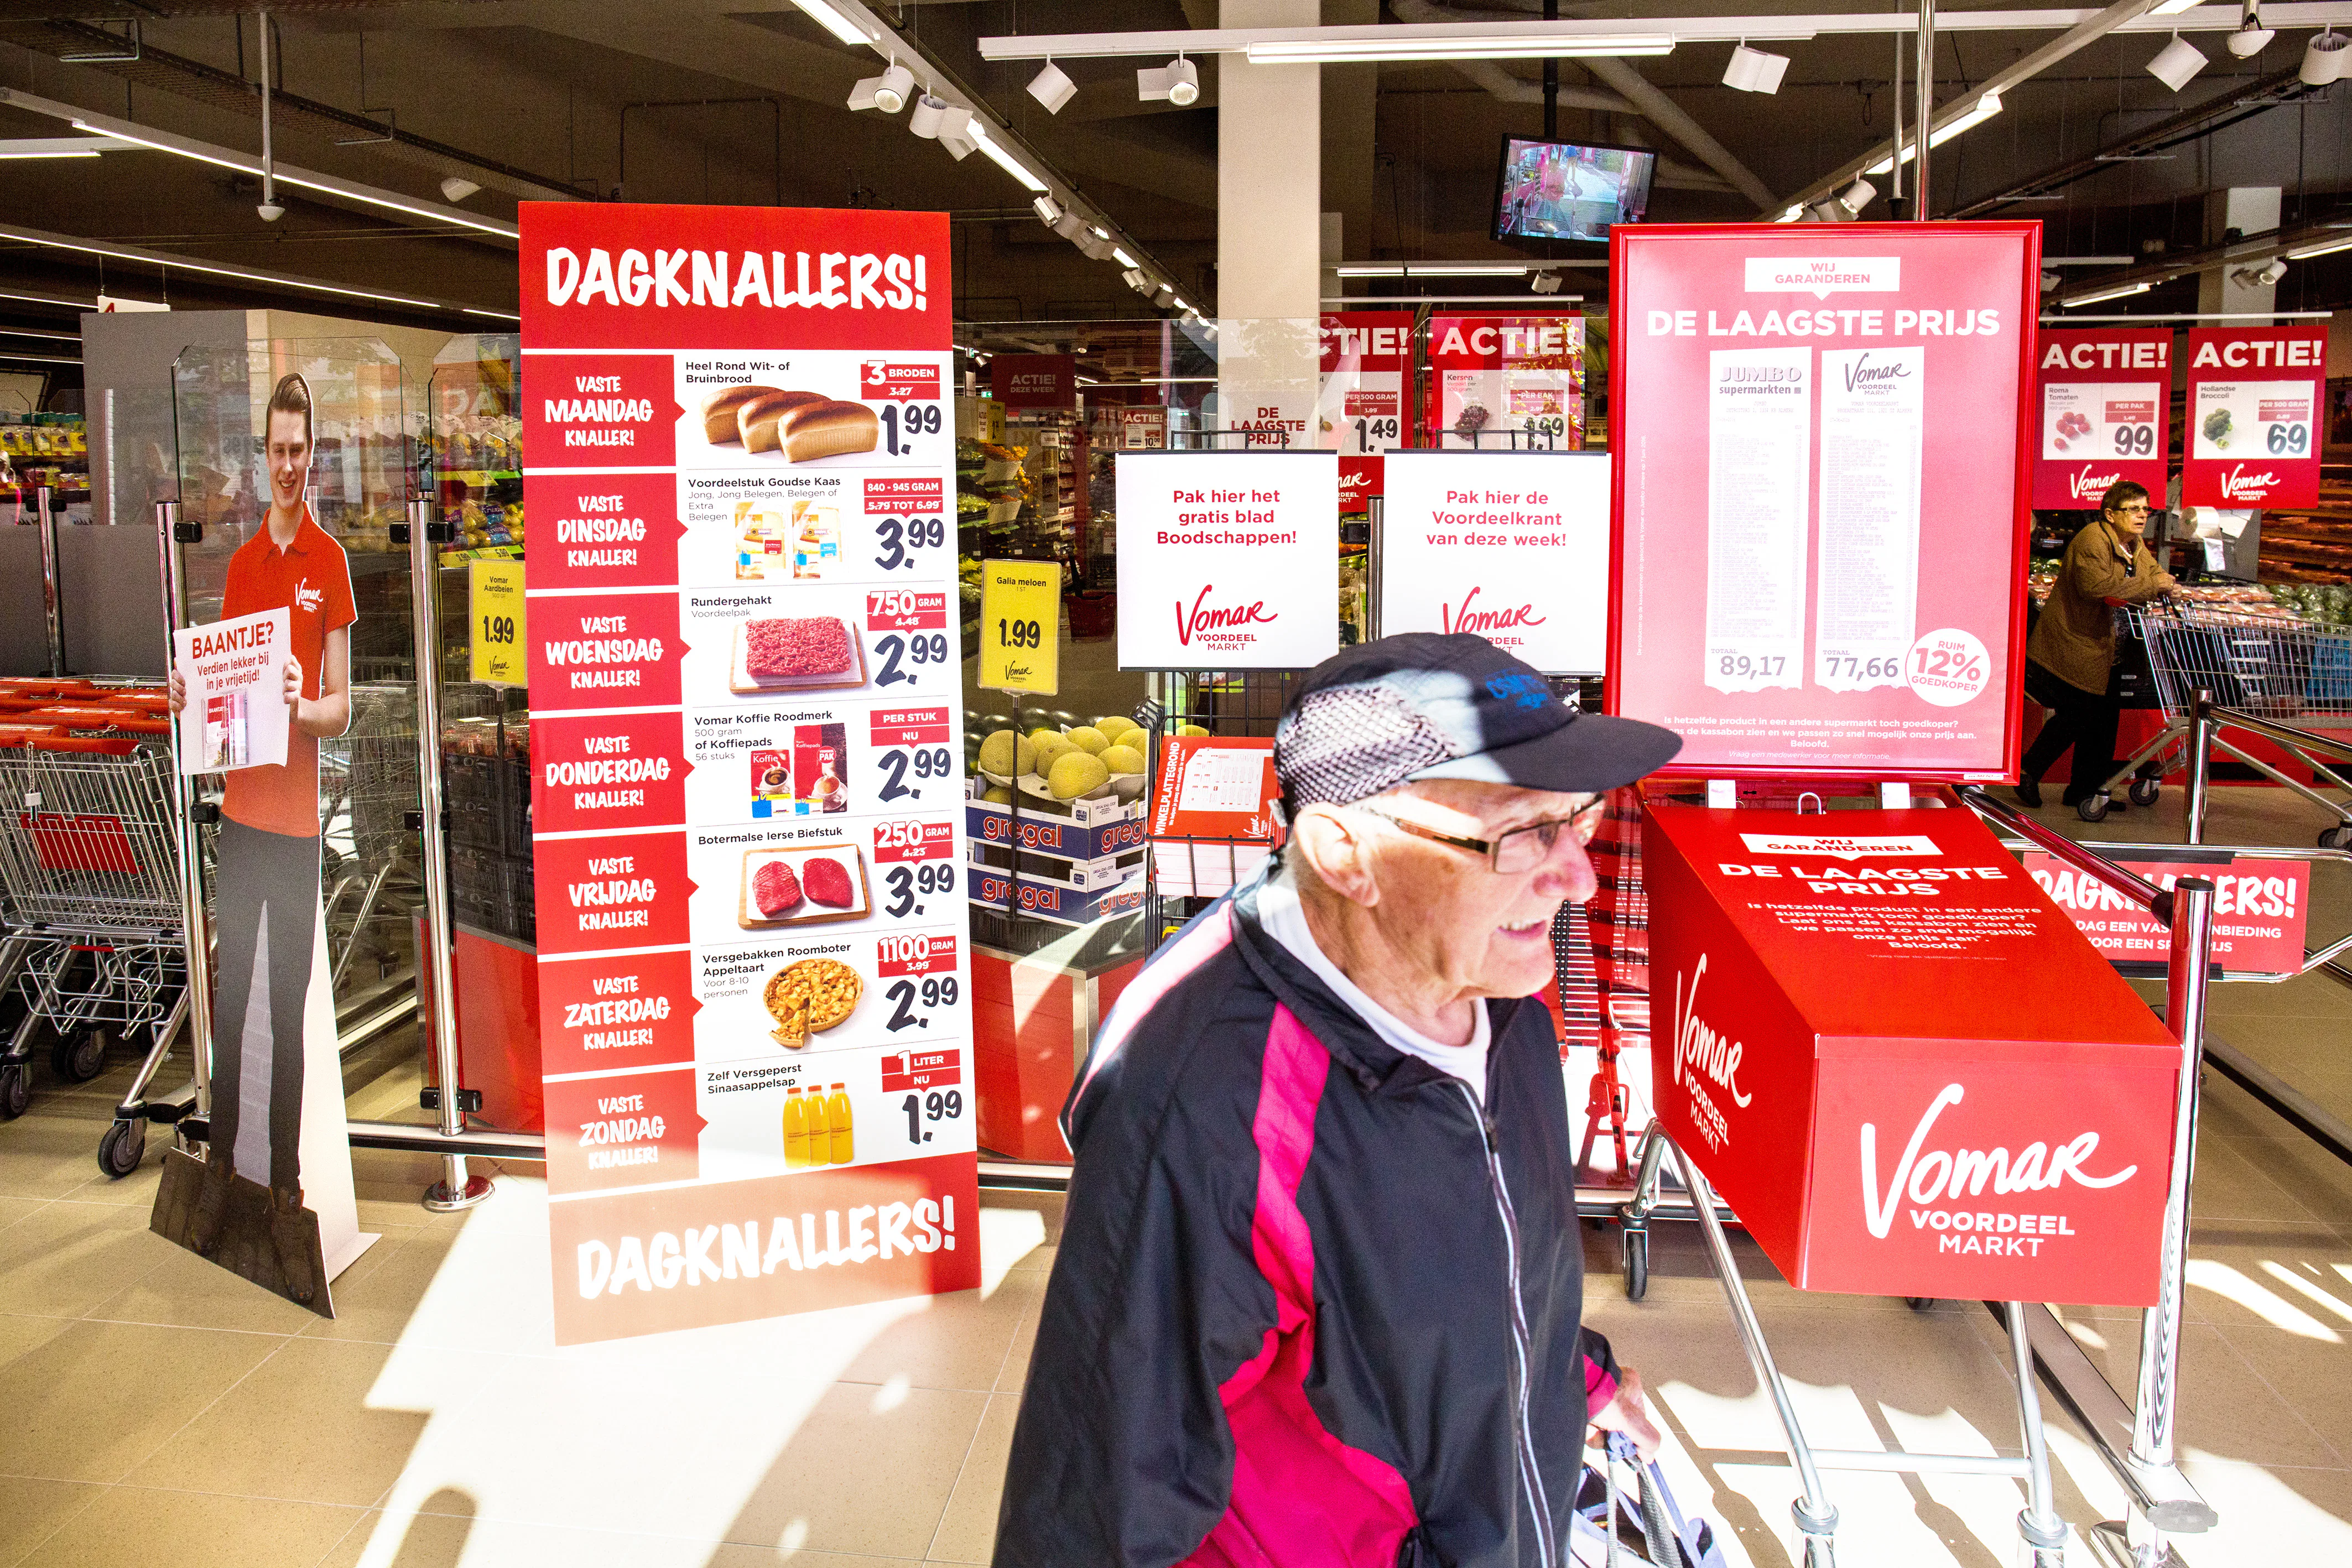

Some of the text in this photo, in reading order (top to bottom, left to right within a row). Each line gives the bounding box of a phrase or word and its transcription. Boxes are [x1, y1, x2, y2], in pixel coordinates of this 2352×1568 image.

[1810, 263, 1835, 272] WIJ
[547, 247, 927, 311] DAGKNALLERS!
[1775, 273, 1871, 284] GARANDEREN
[1647, 309, 2000, 336] DE LAAGSTE PRIJS
[1438, 326, 1575, 355] ACTIE!
[2041, 343, 2167, 369] ACTIE!
[2192, 341, 2322, 367] ACTIE!
[686, 362, 790, 371] Heel Rond Wit- of
[867, 360, 934, 386] 3 BRODEN
[1845, 353, 1911, 393] Vomar
[575, 376, 622, 393] VASTE
[686, 374, 752, 383] Bruinbrood
[1011, 374, 1056, 384] ACTIE!
[1719, 385, 1791, 396] supermarkten
[545, 399, 654, 423] MAANDAG
[1125, 414, 1163, 423] ACTIE!
[1257, 408, 1279, 418] DE
[881, 404, 941, 456] 1.99
[1231, 420, 1305, 431] LAAGSTE
[1355, 419, 1398, 453] 1.49
[565, 429, 634, 446] KNALLER!
[1248, 434, 1290, 445] PRIJS
[2115, 425, 2153, 456] 99
[2267, 424, 2307, 455] 69
[688, 477, 840, 487] Voordeelstuk Goudse Kaas
[867, 483, 885, 492] 840
[912, 483, 939, 491] GRAM
[2221, 463, 2280, 498] Vomar
[688, 491, 715, 501] Jong,
[717, 491, 741, 501] Jong
[745, 490, 784, 500] Belegen,
[788, 489, 825, 499] Belegen
[1173, 489, 1280, 503] Pak hier het
[1446, 491, 1549, 504] Pak hier de
[689, 513, 727, 523] Belegen
[1179, 510, 1274, 526] gratis blad
[1432, 511, 1562, 526] Voordeelkrant
[557, 518, 647, 543] DINSDAG
[1157, 531, 1297, 547] Boodschappen!
[1427, 532, 1566, 547] van deze week!
[875, 518, 945, 571] 3.99
[295, 577, 323, 606] Vomar
[691, 596, 772, 607] Rundergehakt
[691, 610, 751, 618] Voordeelpak
[870, 590, 942, 617] 750 GRAM
[1176, 584, 1278, 646] Vomar
[192, 621, 274, 659] BAANTJE?
[483, 615, 514, 644] 1.99
[999, 618, 1040, 648] 1.99
[545, 638, 664, 666] WOENSDAG
[1938, 640, 1965, 650] RUIM
[197, 652, 269, 676] Verdien lekker bij
[875, 634, 948, 687] 2.99
[1006, 660, 1032, 680] Vomar
[1720, 655, 1786, 680] 89,17
[1826, 658, 1898, 681] 77,66
[1916, 648, 1981, 681] 12%
[206, 669, 259, 690] in je vrijetijd!
[1912, 676, 1978, 692] GOEDKOPER
[695, 711, 832, 726] Vomar Koffie Roodmerk
[1719, 717, 1756, 727] product
[1824, 719, 1877, 728] supermarkt
[1902, 720, 1958, 729] goedkoper?
[717, 728, 742, 738] gram
[1791, 739, 1830, 748] Beloofd.
[695, 738, 772, 751] of Koffiepads
[711, 752, 735, 760] stuks
[546, 757, 671, 787] DONDERDAG
[1154, 742, 1180, 835] WINKELPLATTEGROND
[699, 827, 842, 845] Botermalse Ierse Biefstuk
[984, 816, 1061, 848] gregal
[568, 879, 656, 908] VRIJDAG
[981, 878, 1060, 911] gregal
[703, 943, 851, 964] Versgebakken Roomboter
[1888, 941, 1966, 950] Beloofd.
[703, 962, 764, 977] Appeltaart
[704, 977, 749, 988] Voor 8-10
[704, 988, 748, 1000] personen
[564, 996, 670, 1028] ZATERDAG
[1674, 952, 1752, 1107] Vomar
[708, 1064, 802, 1082] Zelf Versgeperst
[708, 1078, 795, 1094] Sinaasappelsap
[579, 1116, 666, 1148] ZONDAG
[1860, 1084, 2138, 1238] Vomar
[1909, 1210, 2075, 1236] VOORDEEL
[577, 1195, 955, 1299] DAGKNALLERS!
[1938, 1236, 2043, 1257] MARKT
